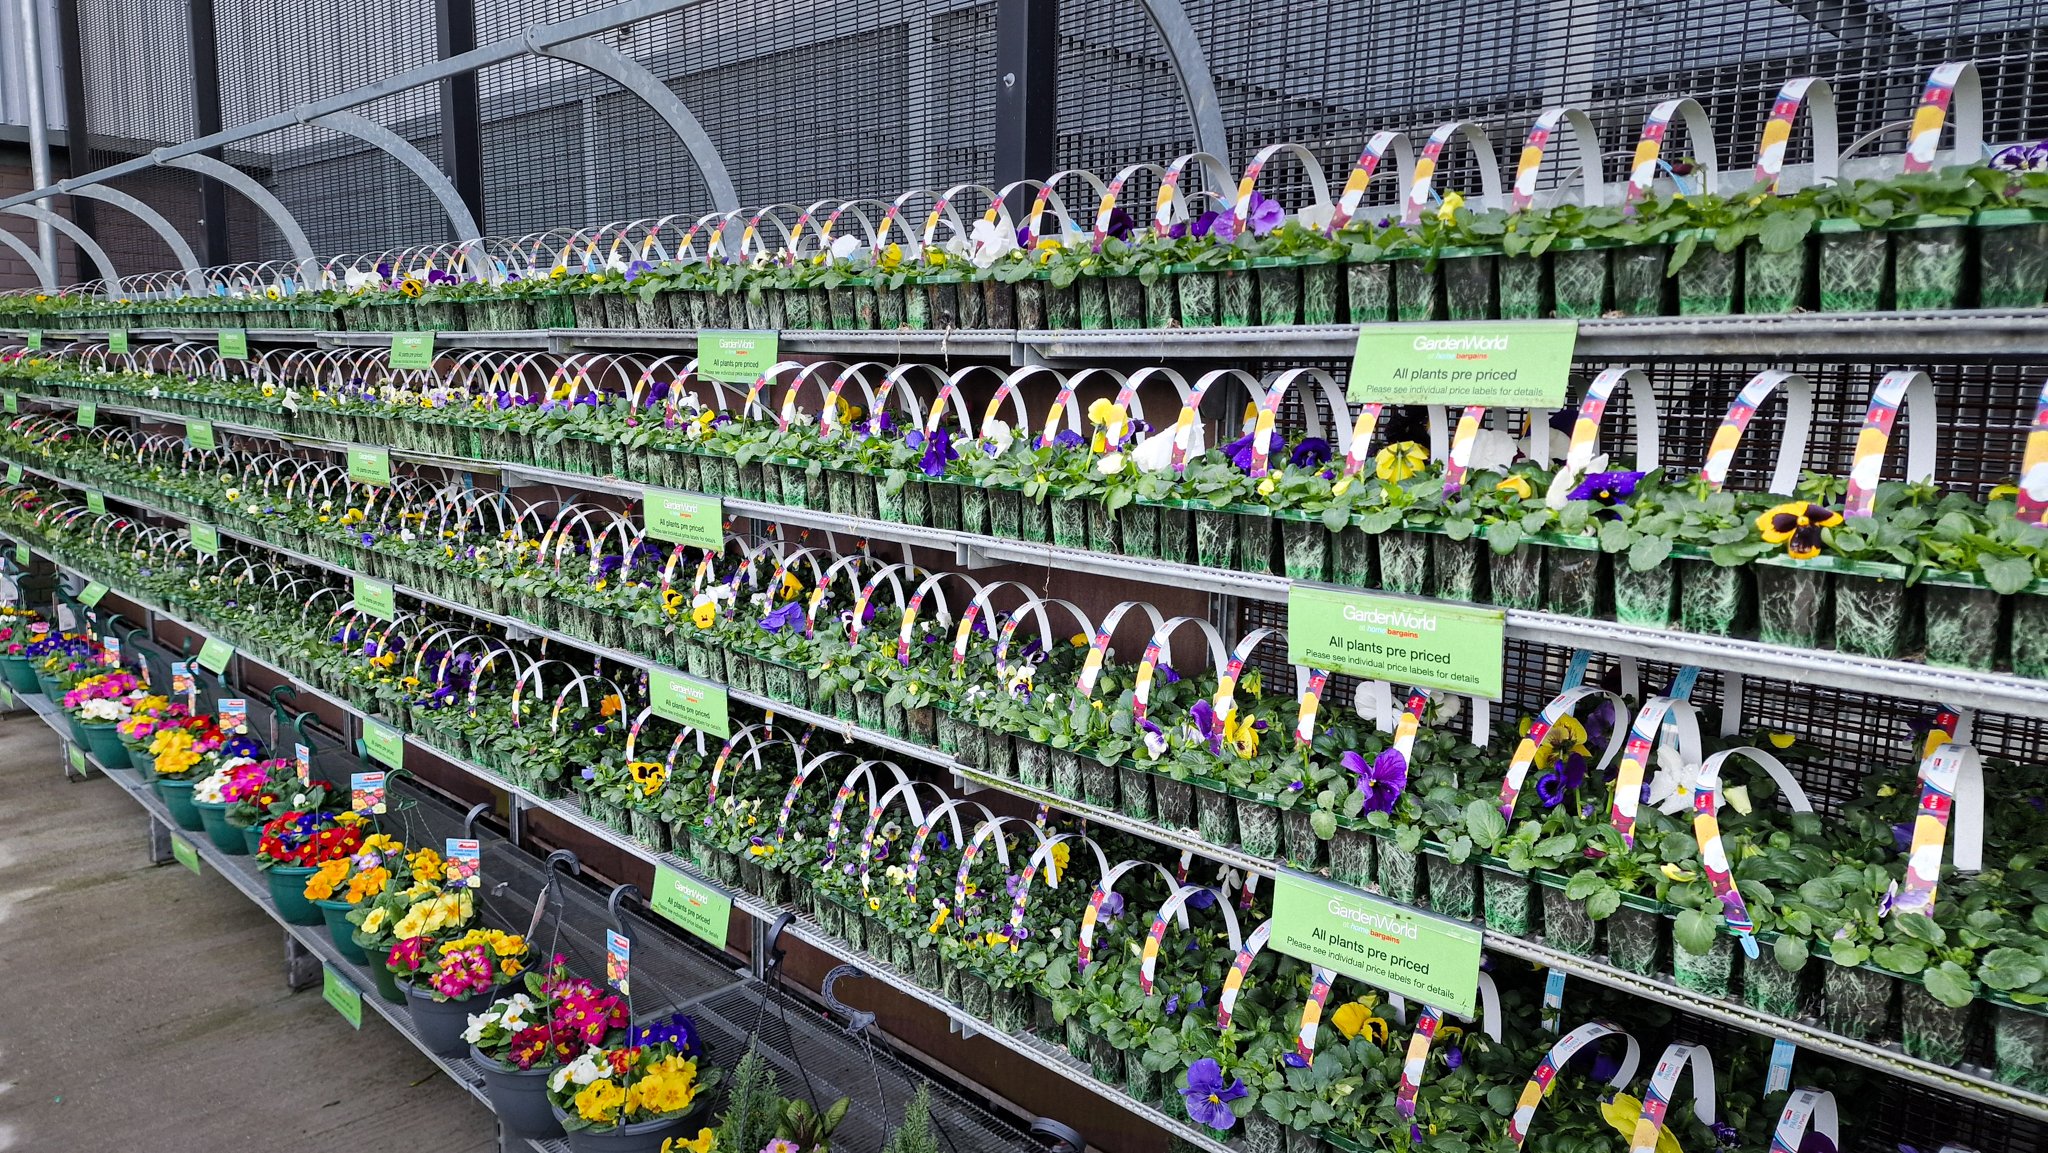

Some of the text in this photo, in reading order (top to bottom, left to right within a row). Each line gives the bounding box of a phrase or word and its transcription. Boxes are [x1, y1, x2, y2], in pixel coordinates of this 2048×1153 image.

[1413, 335, 1508, 350] GardenWorld
[720, 360, 733, 368] plants
[1393, 369, 1517, 382] All plants pre priced
[1410, 386, 1447, 394] individual
[1449, 387, 1470, 395] price
[1472, 387, 1497, 395] labels
[1514, 388, 1543, 396] details
[666, 520, 679, 528] plants
[689, 524, 704, 533] priced
[1343, 605, 1436, 631] GardenWorld
[1387, 628, 1419, 638] bargains
[1329, 636, 1450, 664] All plants pre priced
[1306, 649, 1479, 684] Please see individual price labels for details
[672, 702, 685, 711] plants
[695, 710, 710, 719] priced
[674, 900, 687, 913] plants
[696, 912, 710, 925] priced
[1328, 898, 1417, 940] GardenWorld
[1370, 929, 1400, 945] bargains
[1312, 928, 1429, 975] All plants pre priced
[1287, 936, 1454, 1000] Please see individual price labels for details
